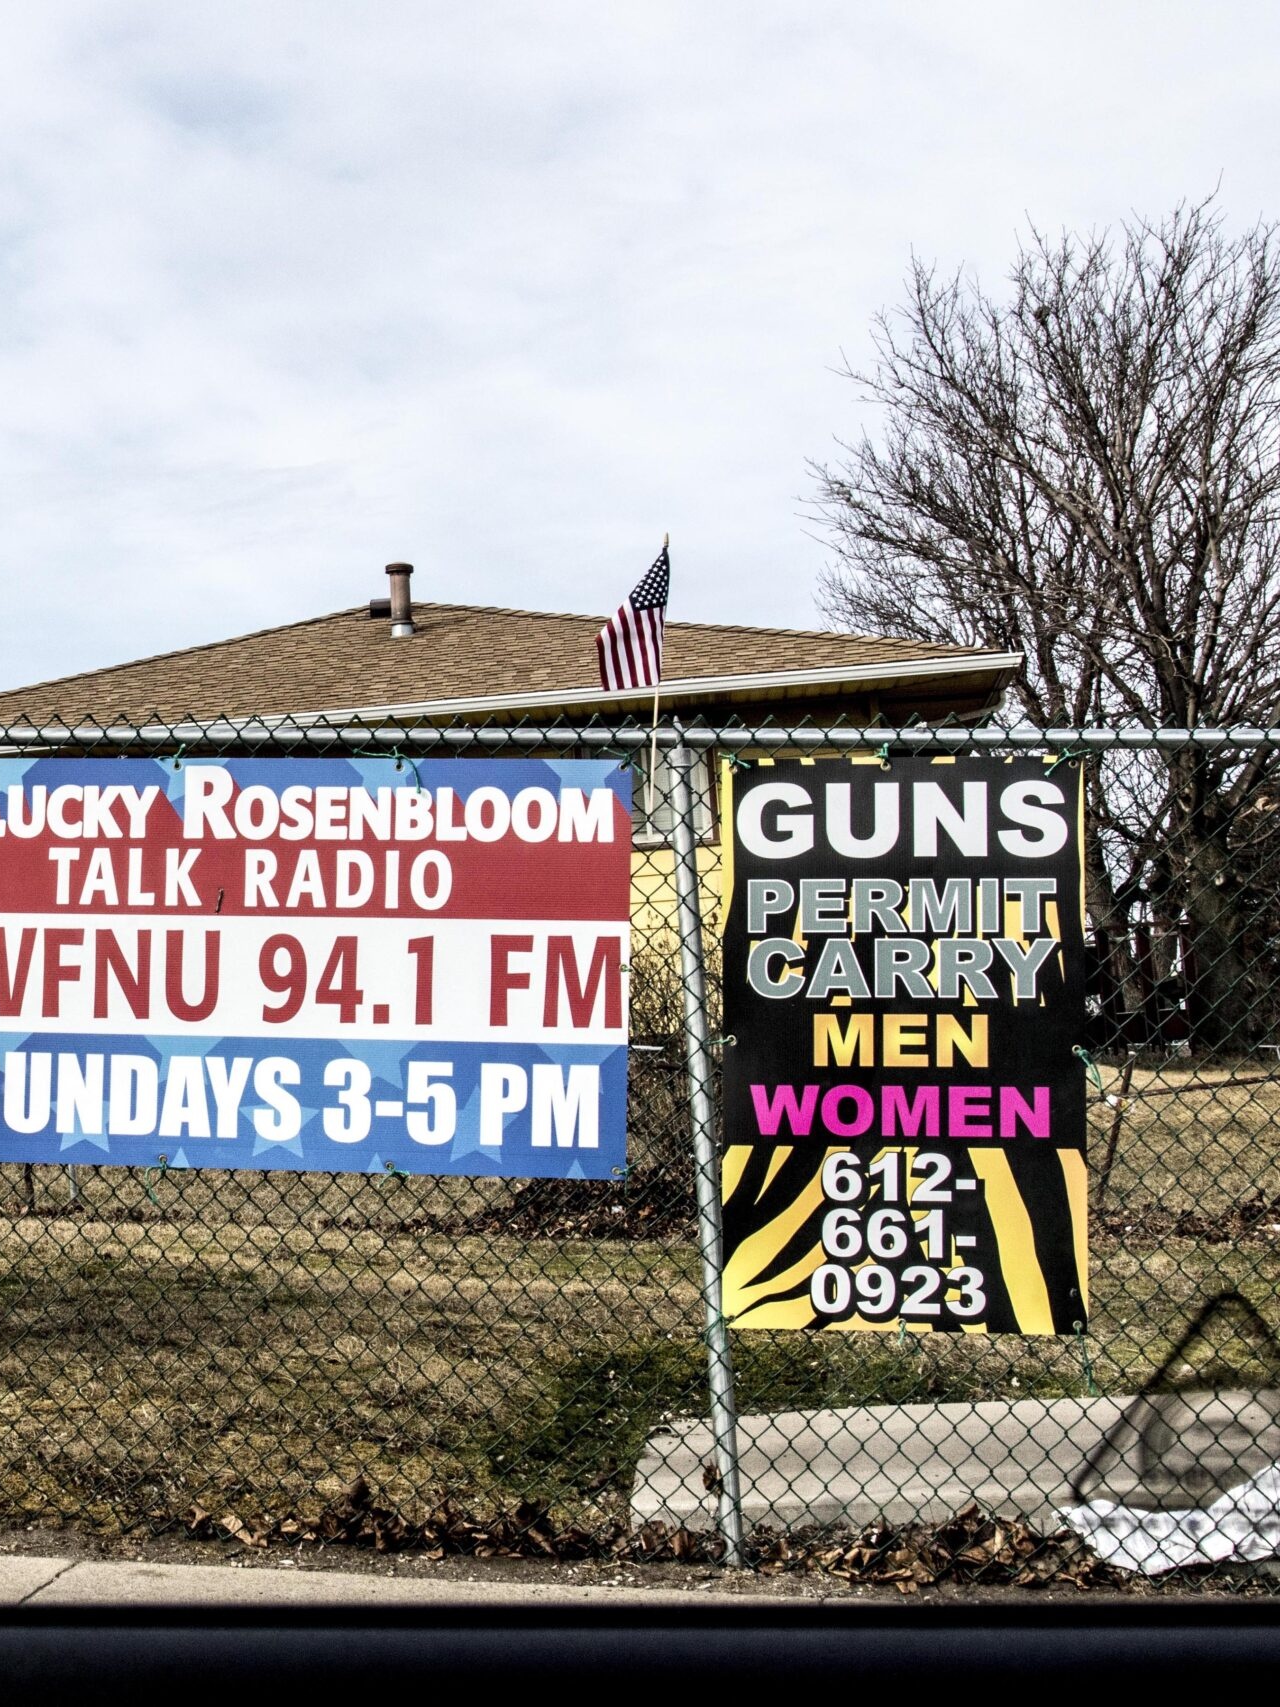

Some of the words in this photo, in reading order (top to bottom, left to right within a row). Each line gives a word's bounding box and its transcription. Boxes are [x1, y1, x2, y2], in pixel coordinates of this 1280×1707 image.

[184, 765, 614, 843] ROSENBLOOM
[736, 779, 1068, 860] GUNS
[48, 847, 203, 908] TALK
[243, 847, 453, 910] RADIO
[747, 877, 1057, 934] PERMIT
[258, 931, 435, 1026] 94.1
[489, 933, 622, 1030] FM
[747, 937, 1058, 999] CARRY
[813, 1013, 990, 1068] MEN
[322, 1059, 456, 1145] 3-5
[479, 1062, 599, 1149] PM
[749, 1084, 1051, 1138] WOMEN
[820, 1151, 977, 1202] 612-
[821, 1208, 977, 1259] 661-
[810, 1264, 987, 1316] 0923
